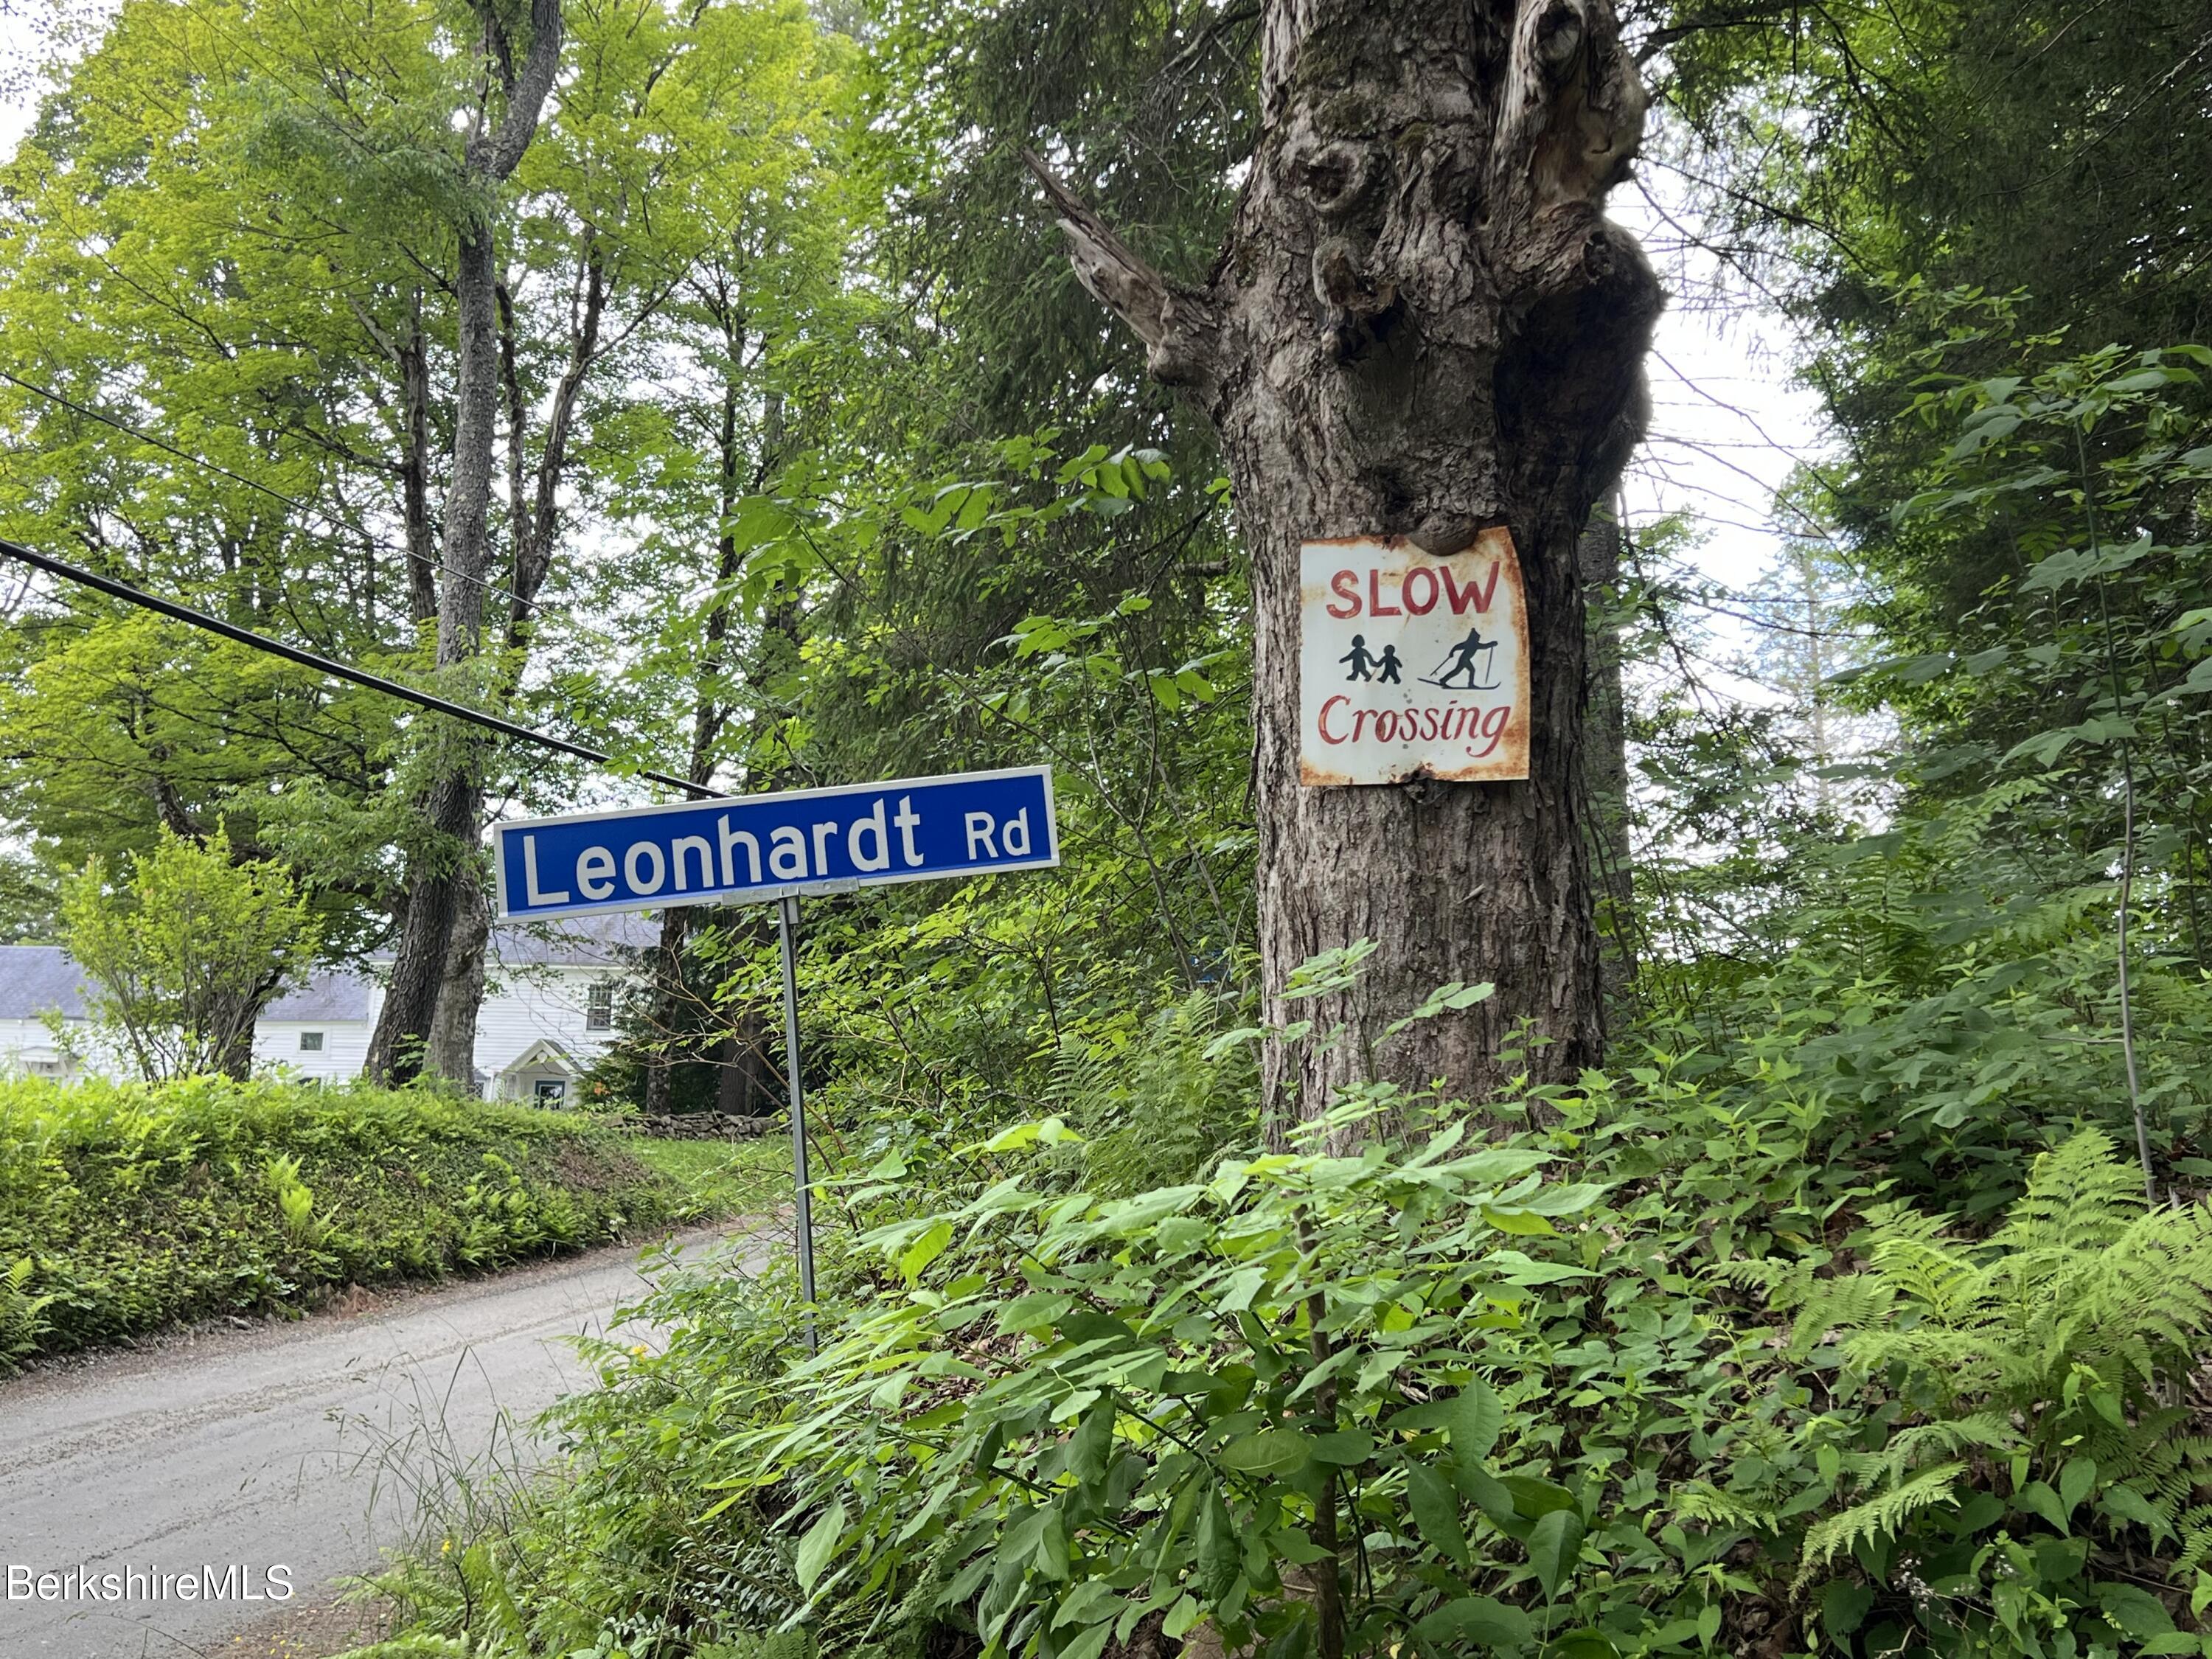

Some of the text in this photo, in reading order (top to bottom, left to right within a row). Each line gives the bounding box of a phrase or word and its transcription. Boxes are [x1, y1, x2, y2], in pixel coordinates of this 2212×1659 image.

[1326, 561, 1500, 619] SLOW
[1318, 695, 1511, 758] Crossing
[523, 795, 1031, 906] Leonhardt Rd
